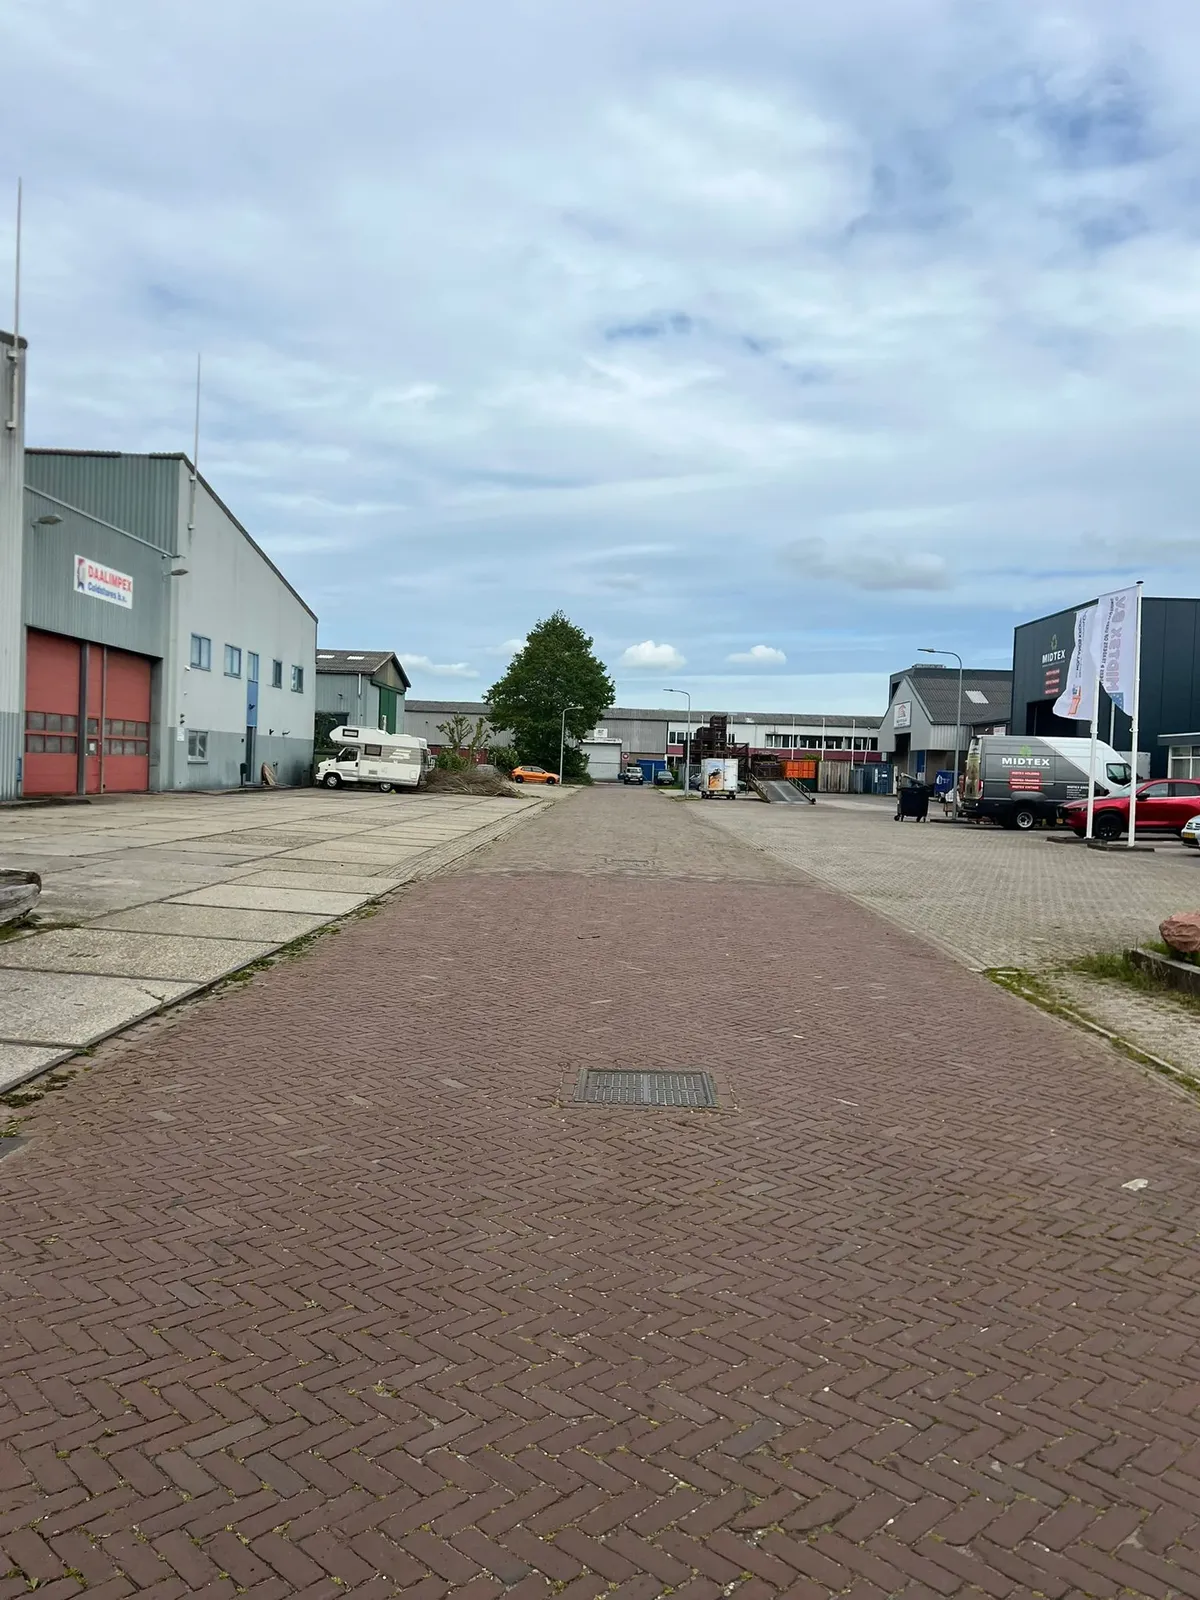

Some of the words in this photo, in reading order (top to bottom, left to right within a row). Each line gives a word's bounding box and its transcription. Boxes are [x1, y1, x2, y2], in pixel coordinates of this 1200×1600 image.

[88, 565, 132, 592] DAALIMPEX
[1042, 649, 1066, 664] MIDTEX
[1002, 757, 1050, 766] MIDTEX
